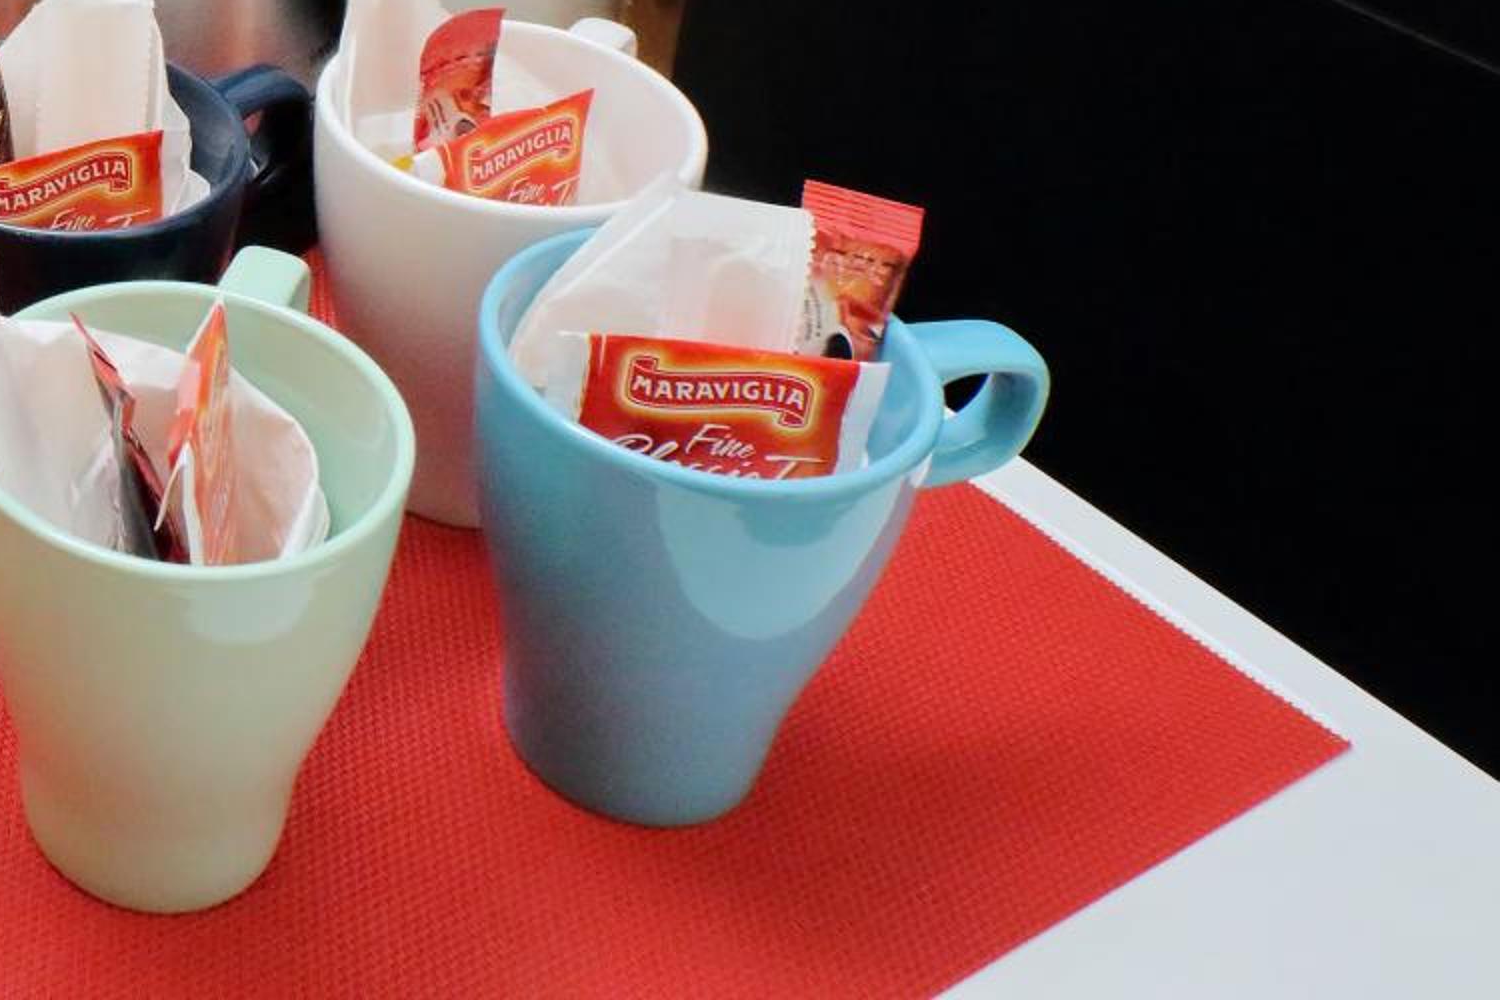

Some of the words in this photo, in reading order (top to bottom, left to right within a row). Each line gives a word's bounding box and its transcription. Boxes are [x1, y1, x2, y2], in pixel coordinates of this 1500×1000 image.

[471, 124, 572, 180] MARAVIGLIA
[631, 374, 806, 411] MARAVIGLIA
[685, 423, 757, 459] Fine
